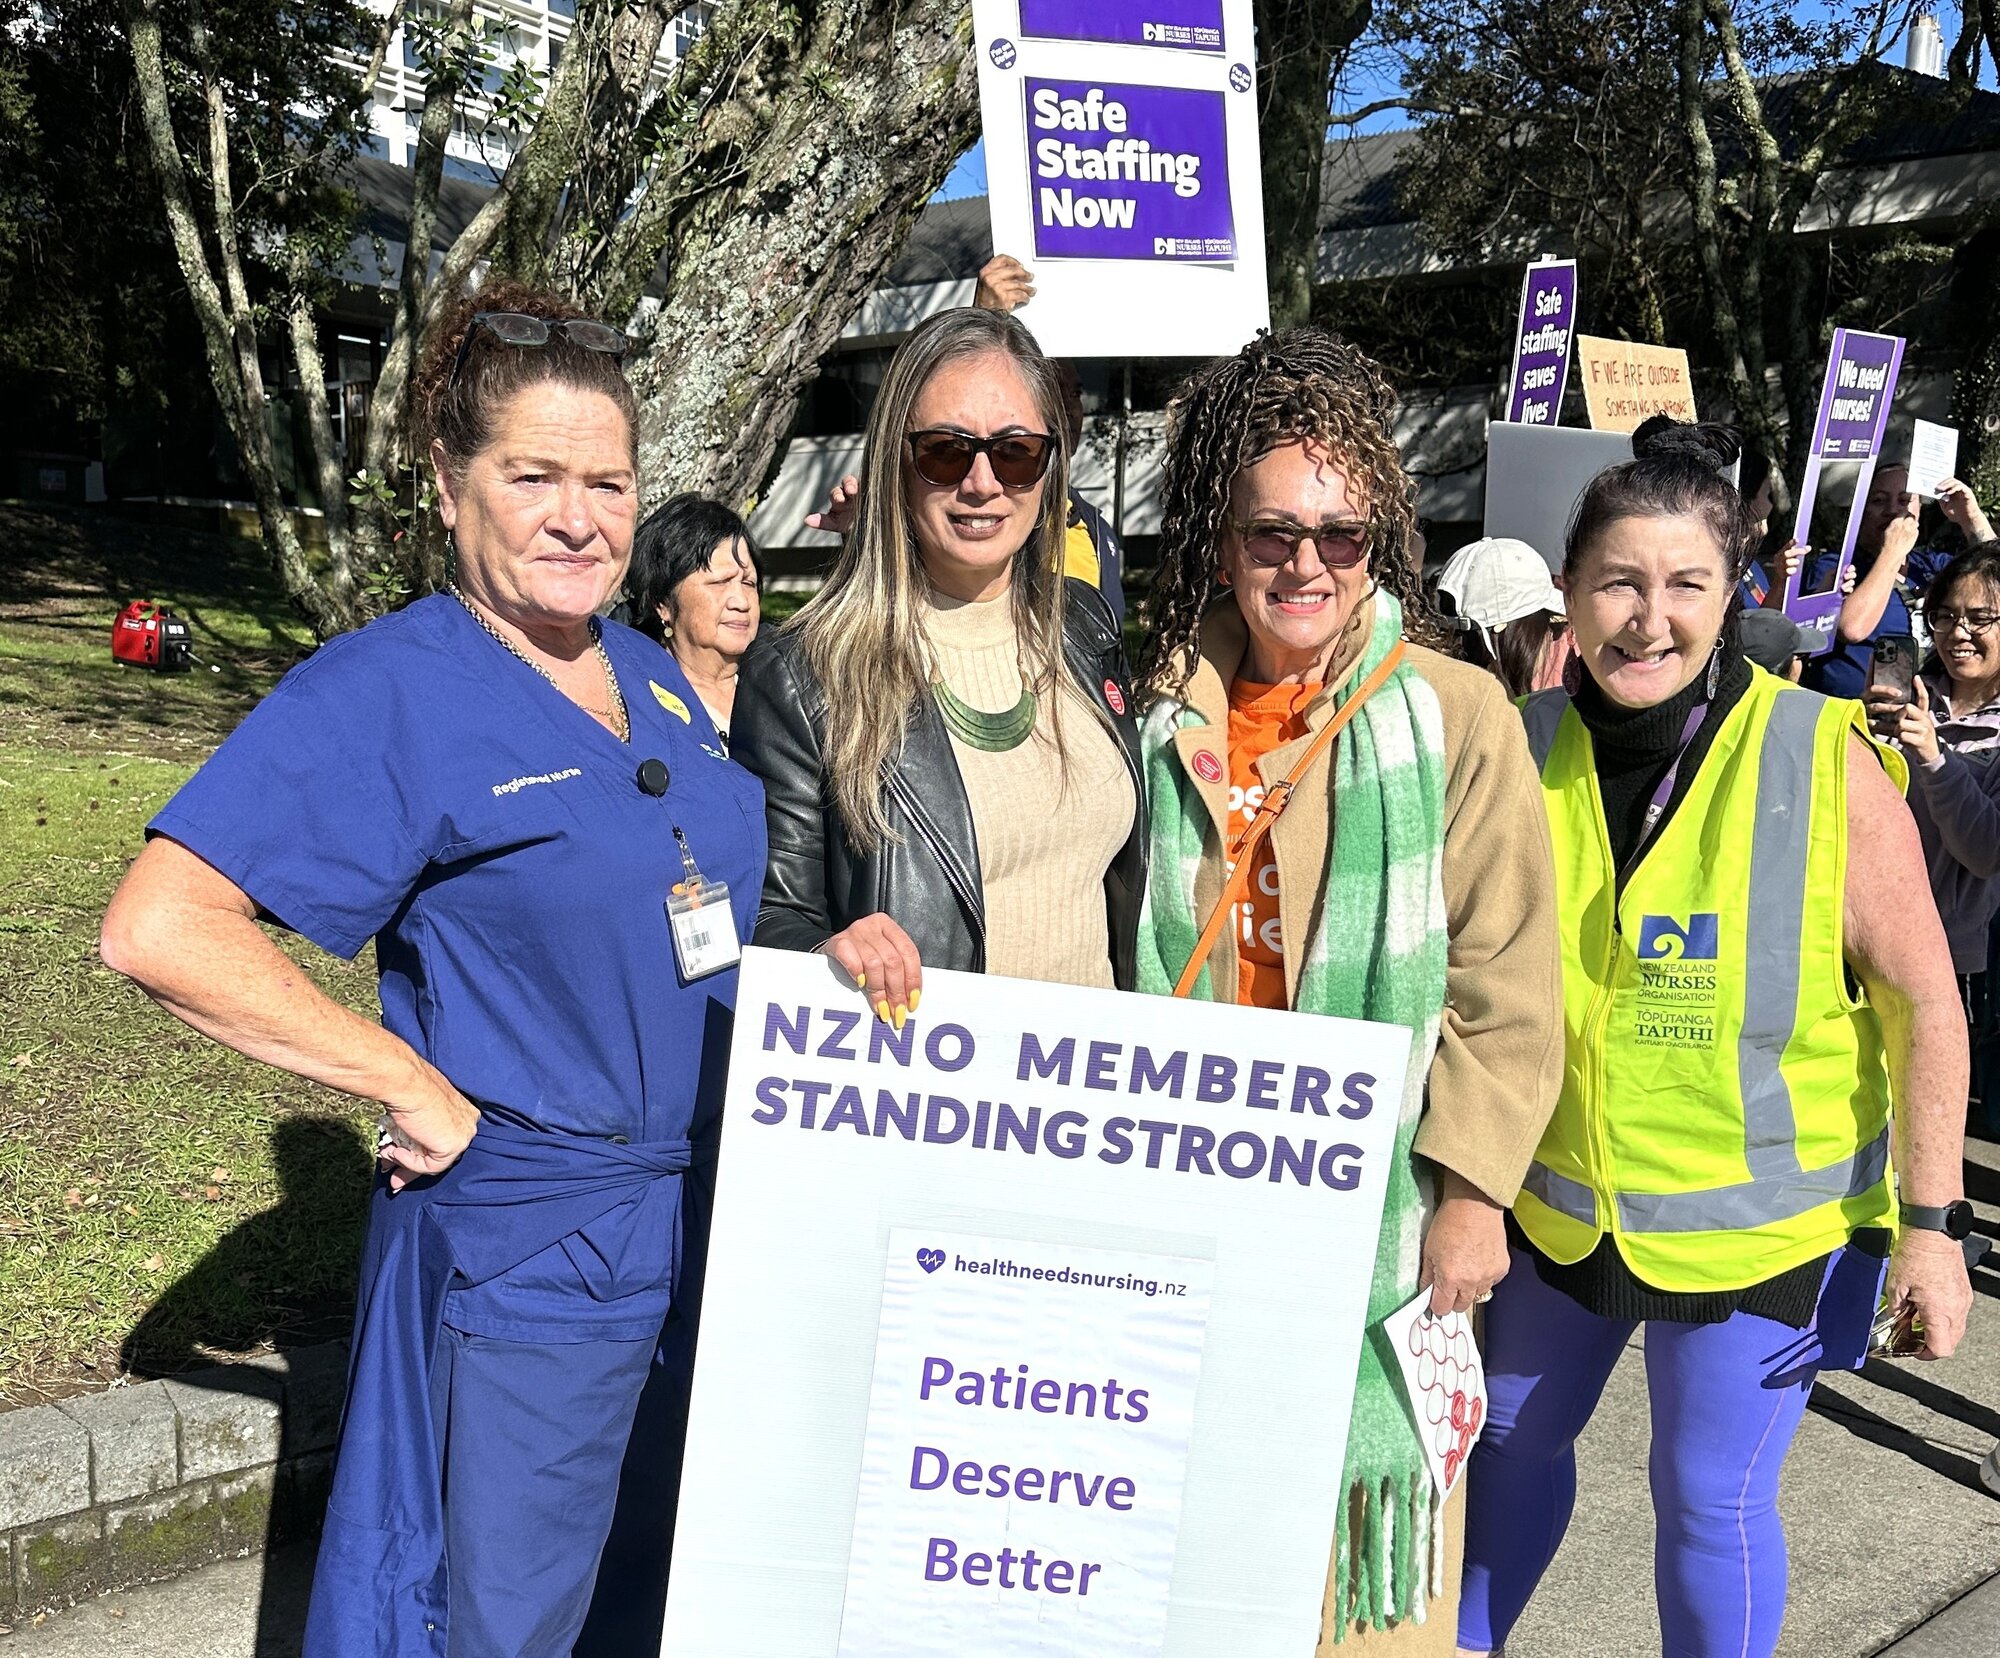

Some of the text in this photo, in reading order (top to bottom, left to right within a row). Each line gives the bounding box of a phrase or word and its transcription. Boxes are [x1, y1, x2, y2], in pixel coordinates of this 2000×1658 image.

[1033, 88, 1127, 133] Safe
[1036, 138, 1200, 198] Staffing
[1040, 187, 1136, 229] Now
[1535, 286, 1562, 317] Safe
[1521, 323, 1568, 358] staffing
[1522, 365, 1557, 391] saves
[1603, 360, 1620, 385] WE
[1624, 362, 1643, 387] ARE
[1648, 365, 1680, 386] OUTSIDE
[1839, 360, 1887, 390] We need
[1521, 397, 1549, 424] lives
[1831, 394, 1875, 422] nurses!
[492, 768, 582, 797] Registered Nurse
[1638, 963, 1716, 973] NEW ZEALAND
[1642, 973, 1716, 990] NURSES
[1638, 989, 1715, 1001] ORGANISATION
[1634, 1024, 1714, 1041] TAPUHI
[762, 1003, 1377, 1121] NZNO MEMBERS
[751, 1076, 1365, 1191] STANDING STRONG
[955, 1255, 1187, 1298] healthneedsnursing.nz
[919, 1356, 1150, 1424] Patients
[909, 1446, 1137, 1511] Deserve
[924, 1538, 1101, 1597] Better
